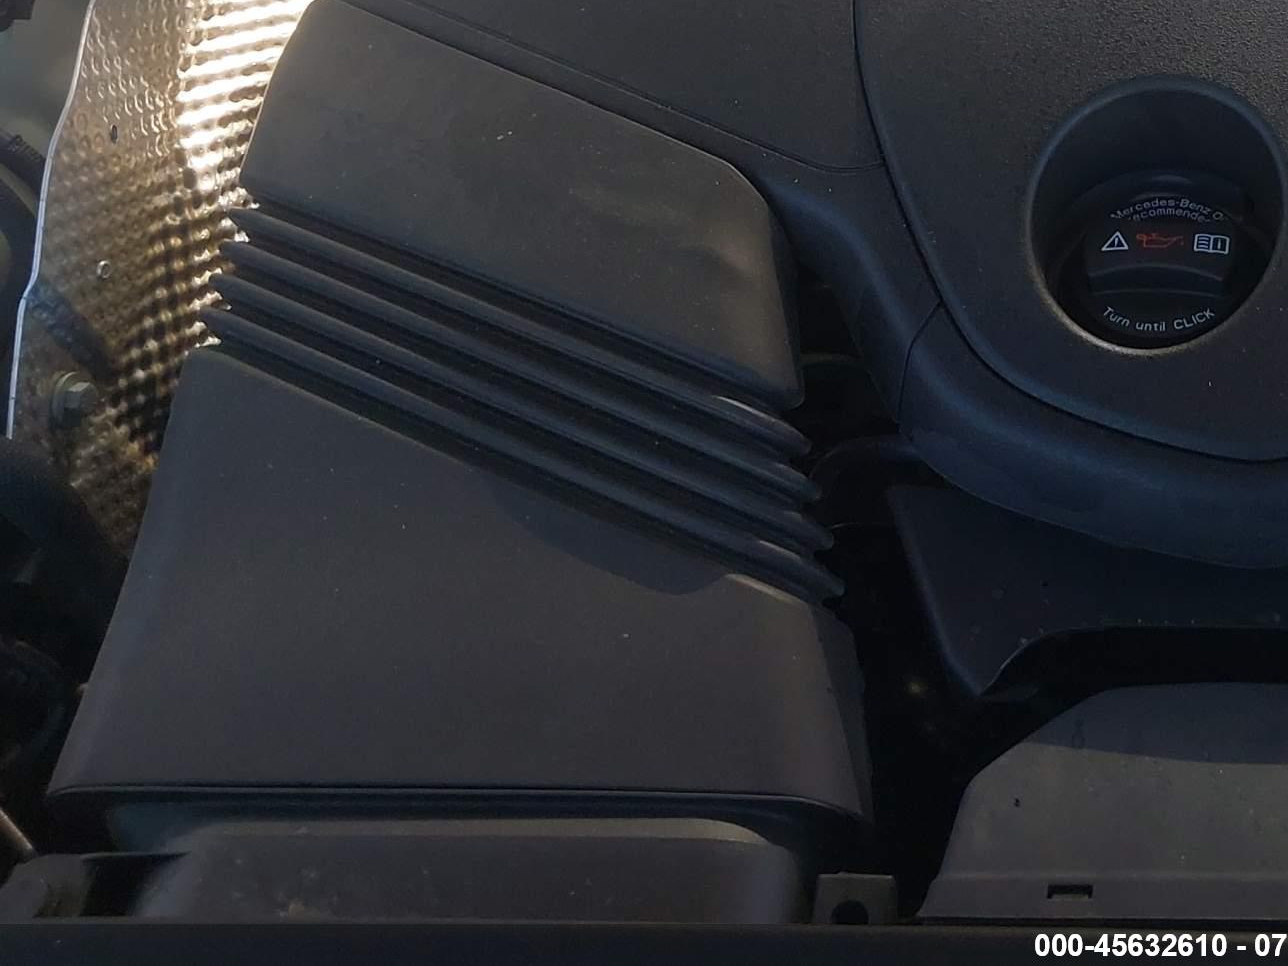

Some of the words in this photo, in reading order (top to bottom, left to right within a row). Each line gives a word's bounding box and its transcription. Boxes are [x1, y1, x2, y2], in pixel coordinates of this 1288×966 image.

[1109, 197, 1213, 219] Mercedes-Benz
[1128, 208, 1212, 223] ecommende
[1103, 306, 1130, 327] Turn
[1135, 321, 1166, 331] until
[1173, 308, 1215, 330] CLICK
